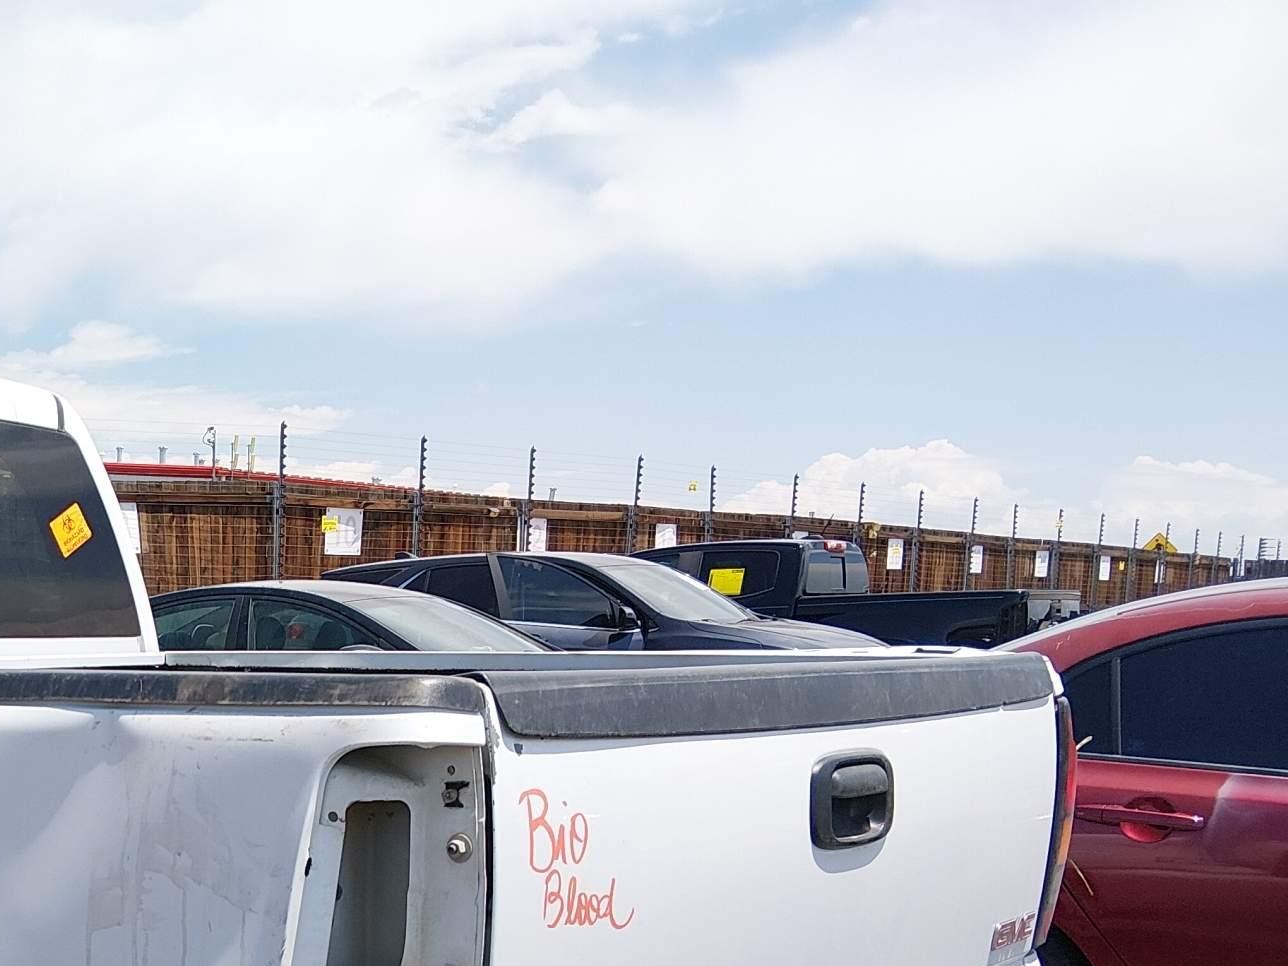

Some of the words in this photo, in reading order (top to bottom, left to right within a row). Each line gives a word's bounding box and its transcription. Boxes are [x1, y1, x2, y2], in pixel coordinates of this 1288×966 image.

[519, 788, 588, 873] Bio
[543, 869, 634, 929] Blood
[992, 911, 1036, 950] GMC
